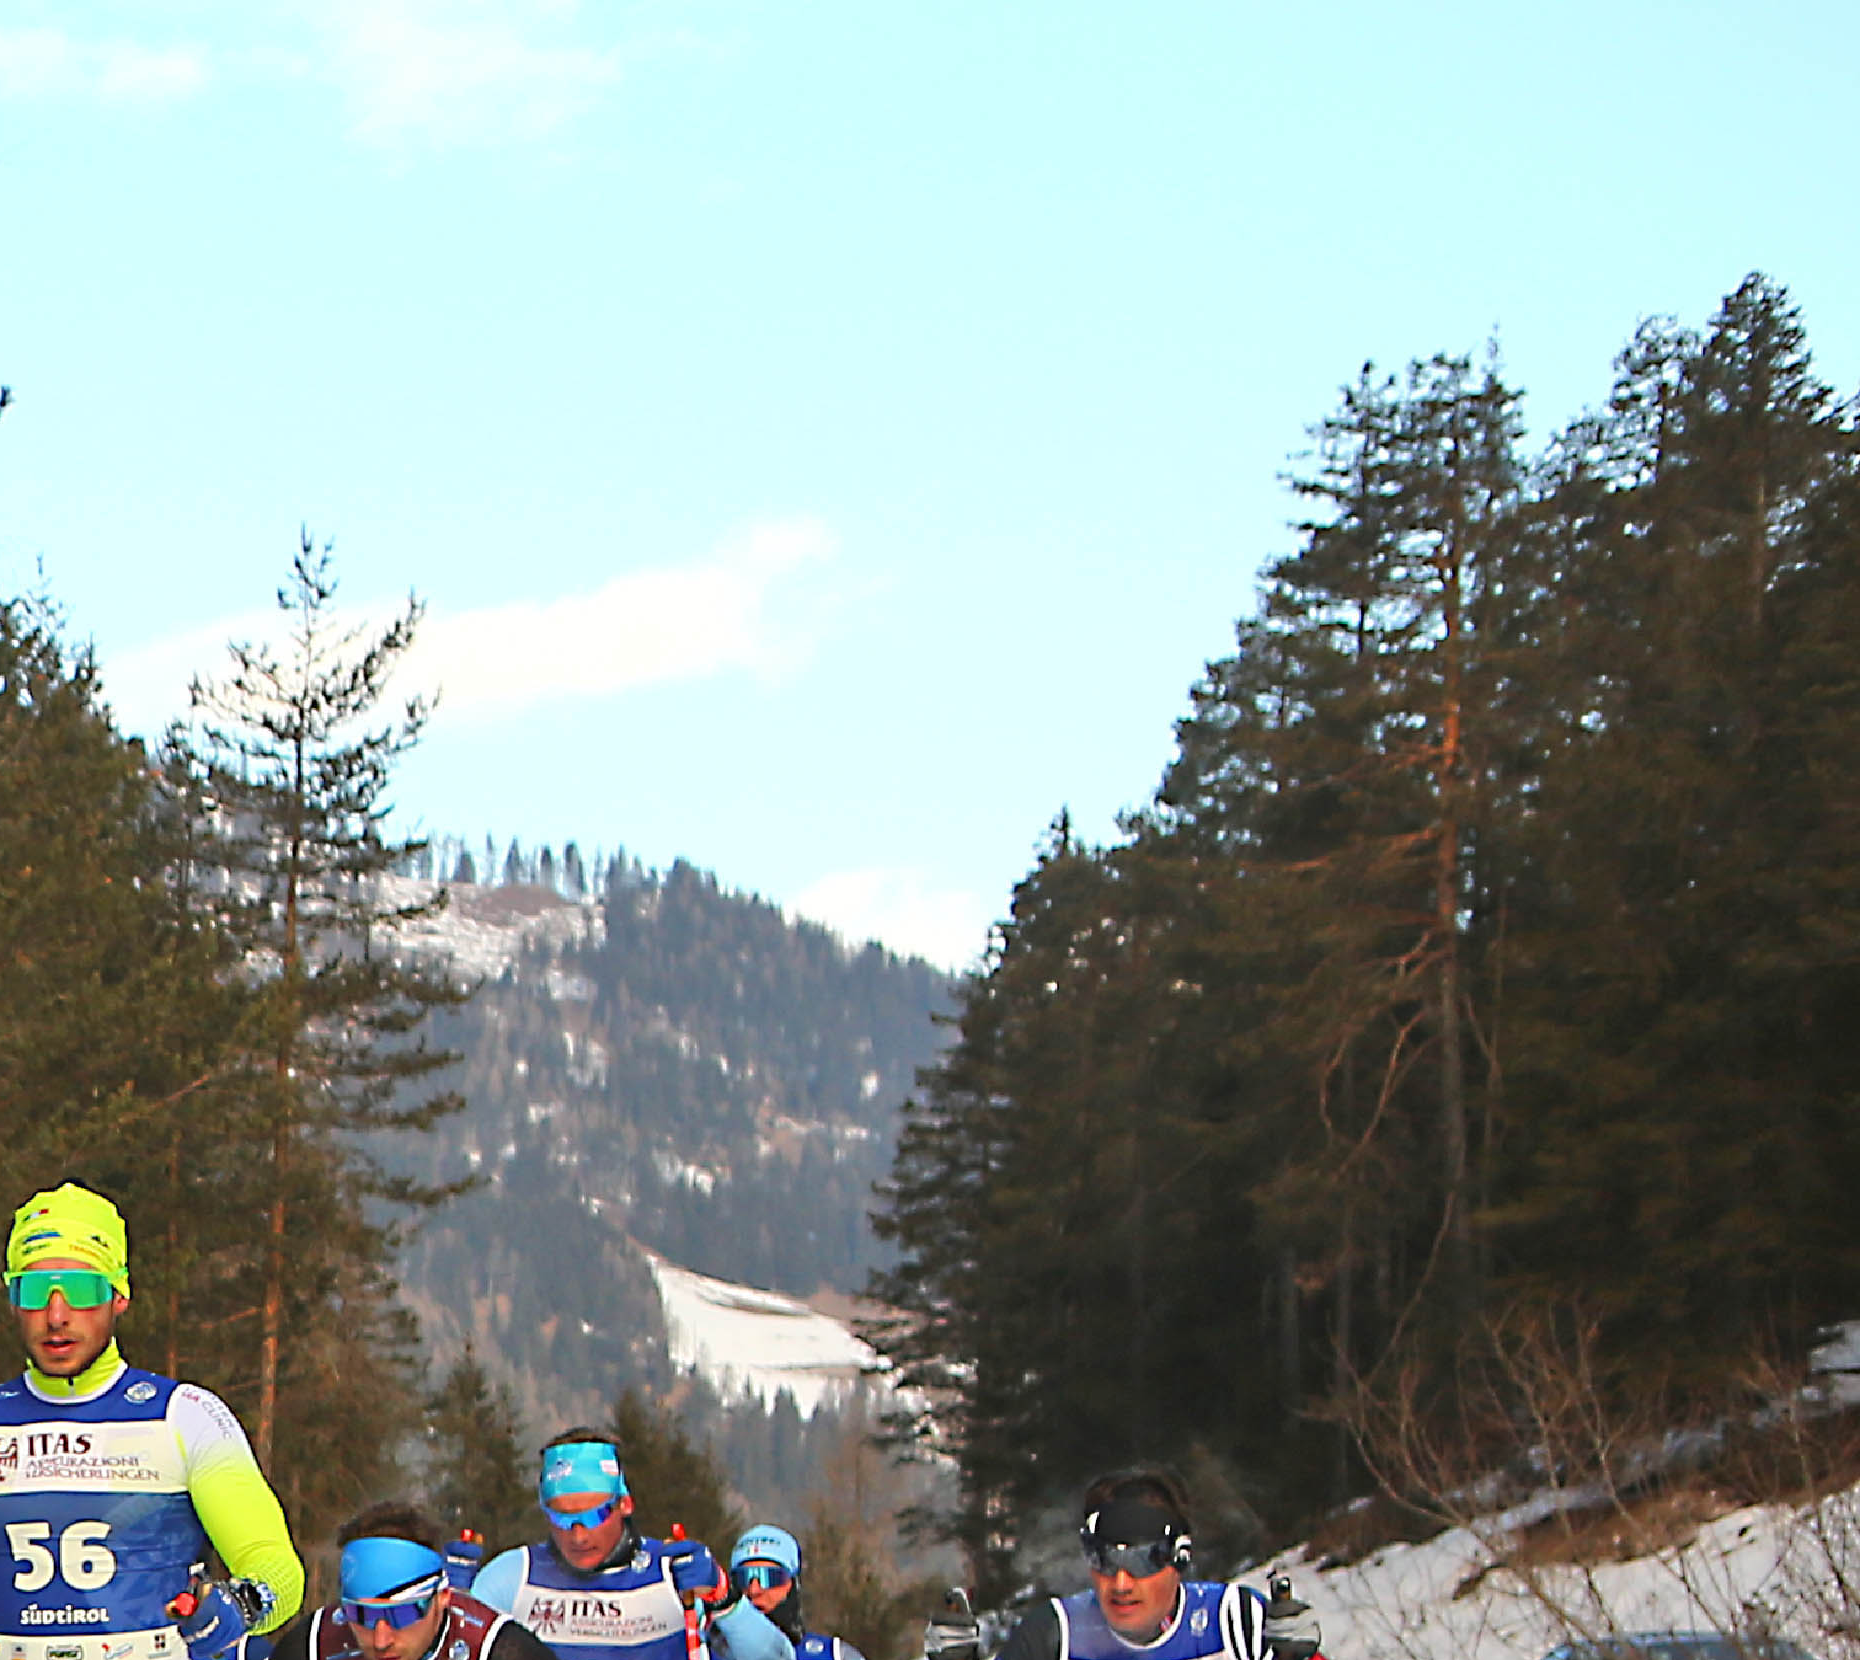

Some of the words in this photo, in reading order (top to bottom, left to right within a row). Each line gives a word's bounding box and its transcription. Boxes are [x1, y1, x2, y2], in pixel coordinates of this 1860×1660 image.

[27, 1432, 93, 1456] ITAS
[4, 1519, 117, 1592] 56
[572, 1600, 622, 1617] ITAS
